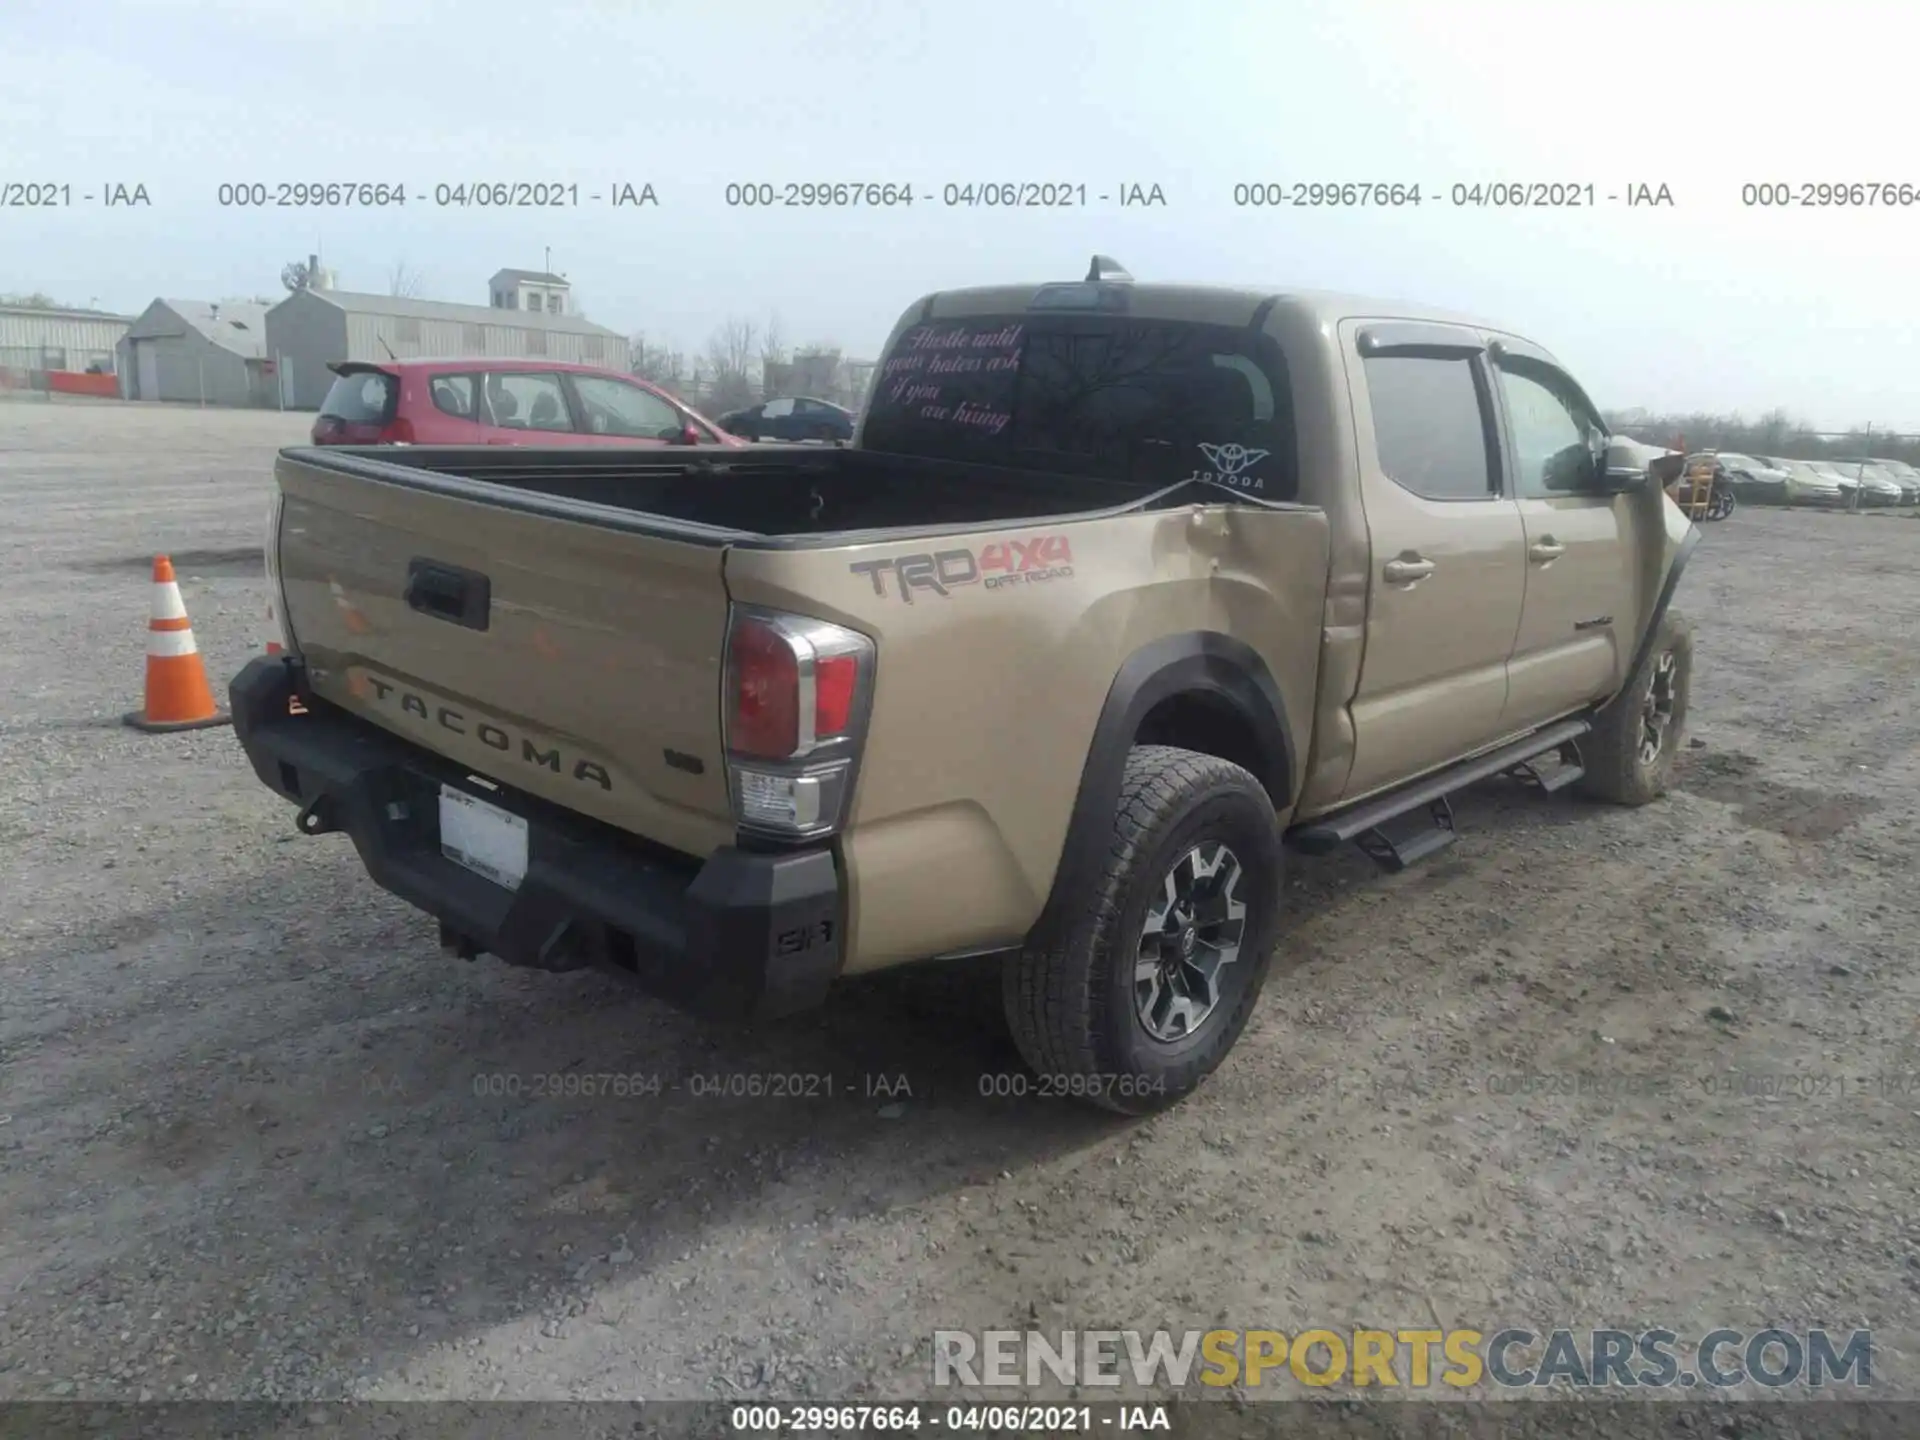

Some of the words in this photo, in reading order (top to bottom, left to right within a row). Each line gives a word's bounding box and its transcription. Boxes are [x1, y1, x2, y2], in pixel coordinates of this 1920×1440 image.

[911, 326, 969, 349] Hustle
[972, 323, 1025, 347] until
[927, 353, 982, 373] haters
[985, 347, 1021, 372] ask
[902, 385, 941, 406] you
[849, 548, 982, 605] TRD
[367, 677, 613, 792] TACOMA
